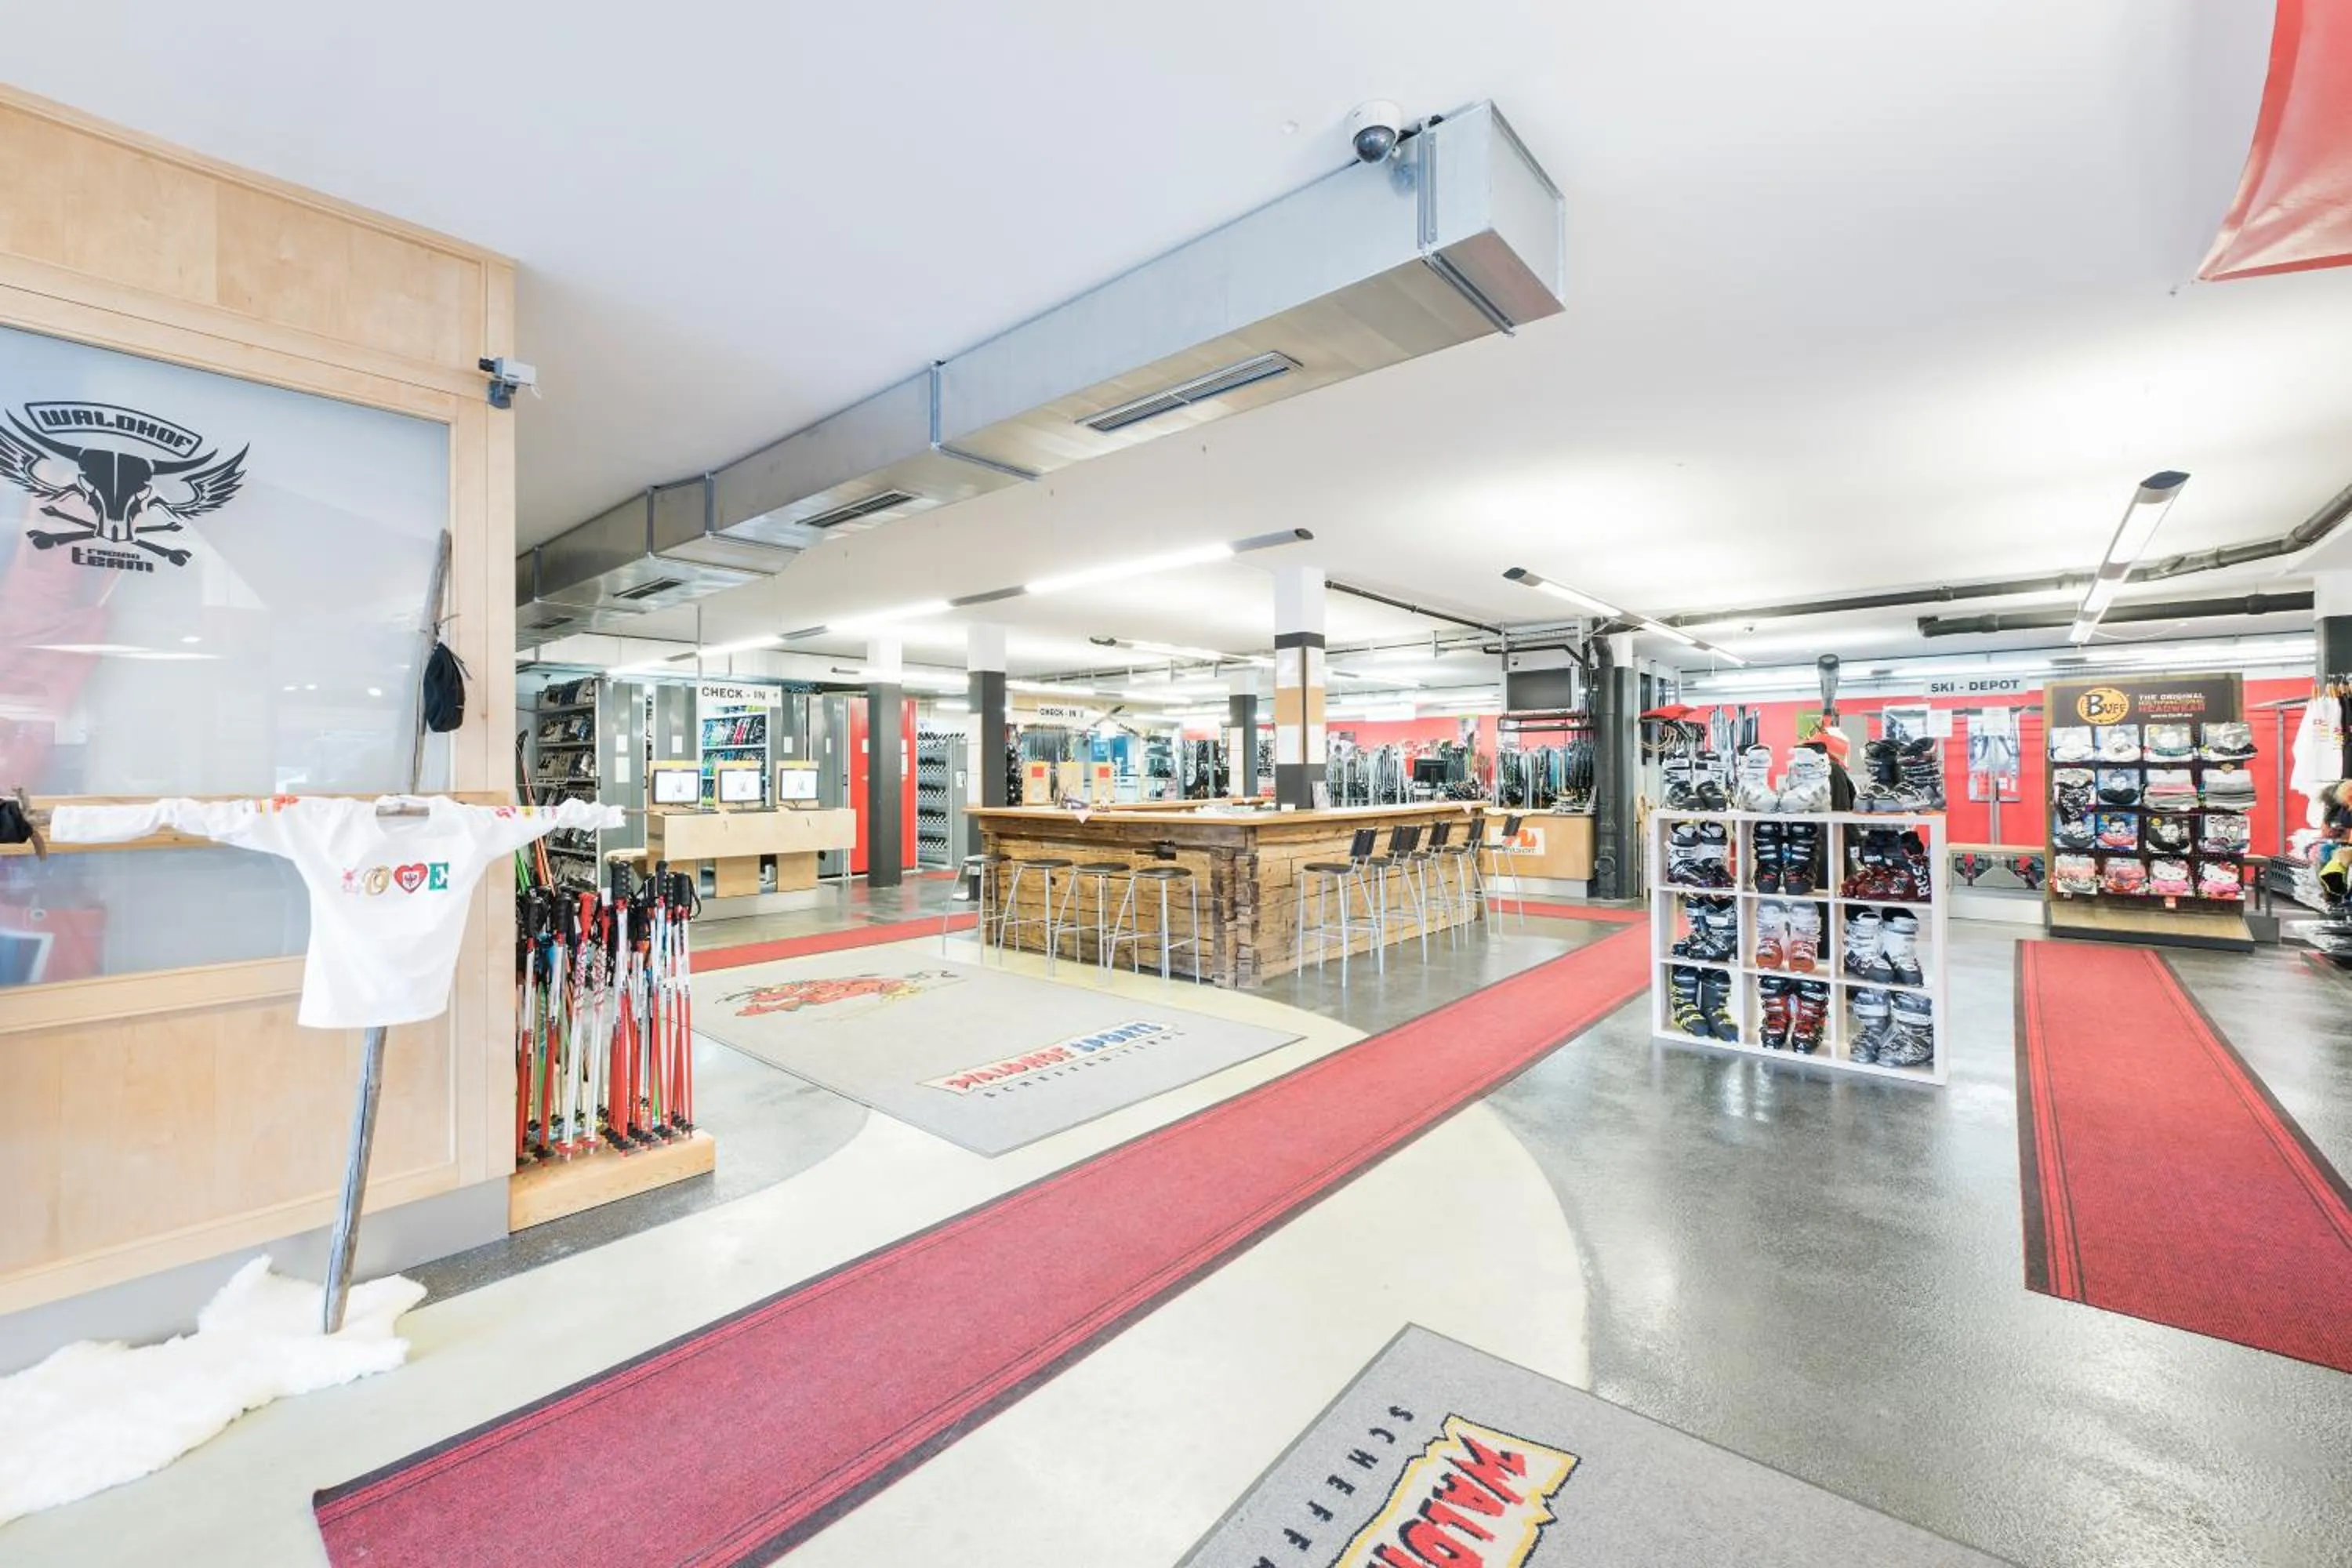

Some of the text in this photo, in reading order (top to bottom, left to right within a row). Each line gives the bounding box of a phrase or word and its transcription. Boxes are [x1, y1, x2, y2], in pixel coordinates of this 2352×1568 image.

[39, 409, 193, 448] WALDHOF
[1931, 682, 1955, 692] SKI
[1969, 680, 2020, 691] DEPOT
[702, 686, 743, 699] CHECK
[753, 691, 766, 700] IN
[1040, 708, 1064, 717] CHECK
